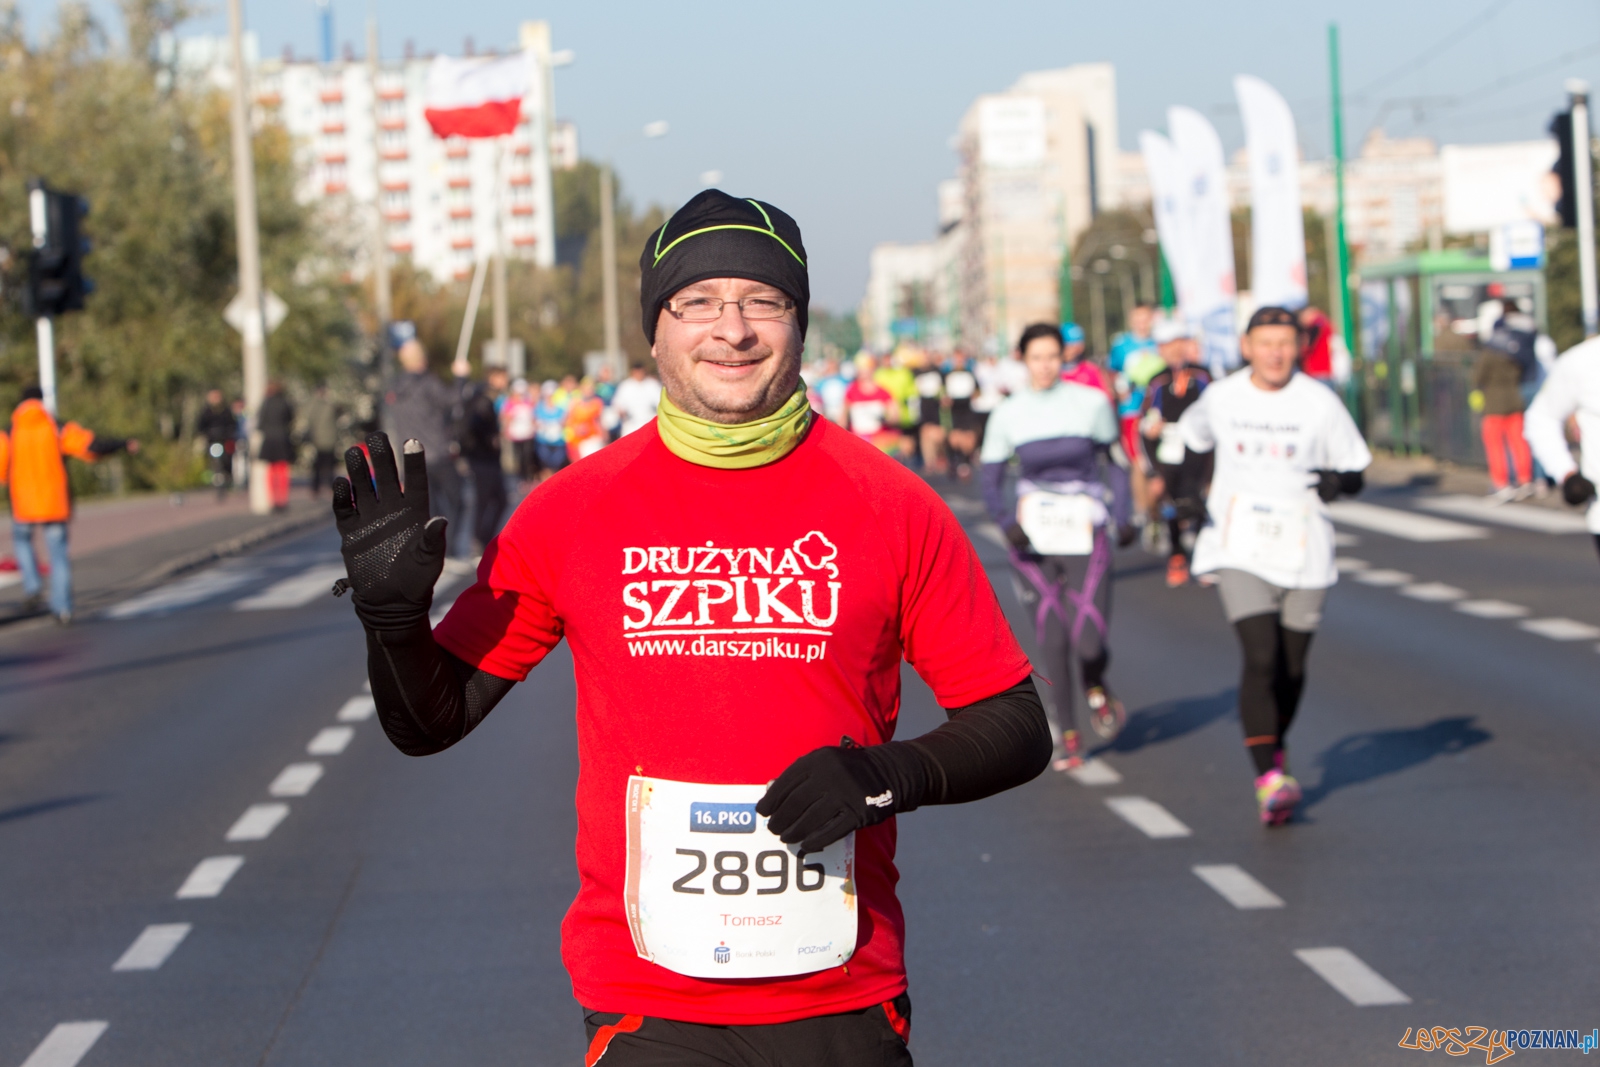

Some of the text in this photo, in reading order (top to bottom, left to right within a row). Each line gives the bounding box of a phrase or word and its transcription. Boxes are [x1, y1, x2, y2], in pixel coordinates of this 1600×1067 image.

[621, 540, 804, 575] DRUŻYNA
[622, 576, 842, 630] SZPIKU
[627, 635, 827, 663] www.darszpiku.pl
[718, 810, 752, 826] PKO
[672, 847, 825, 895] 2896
[720, 913, 783, 927] Tomasz
